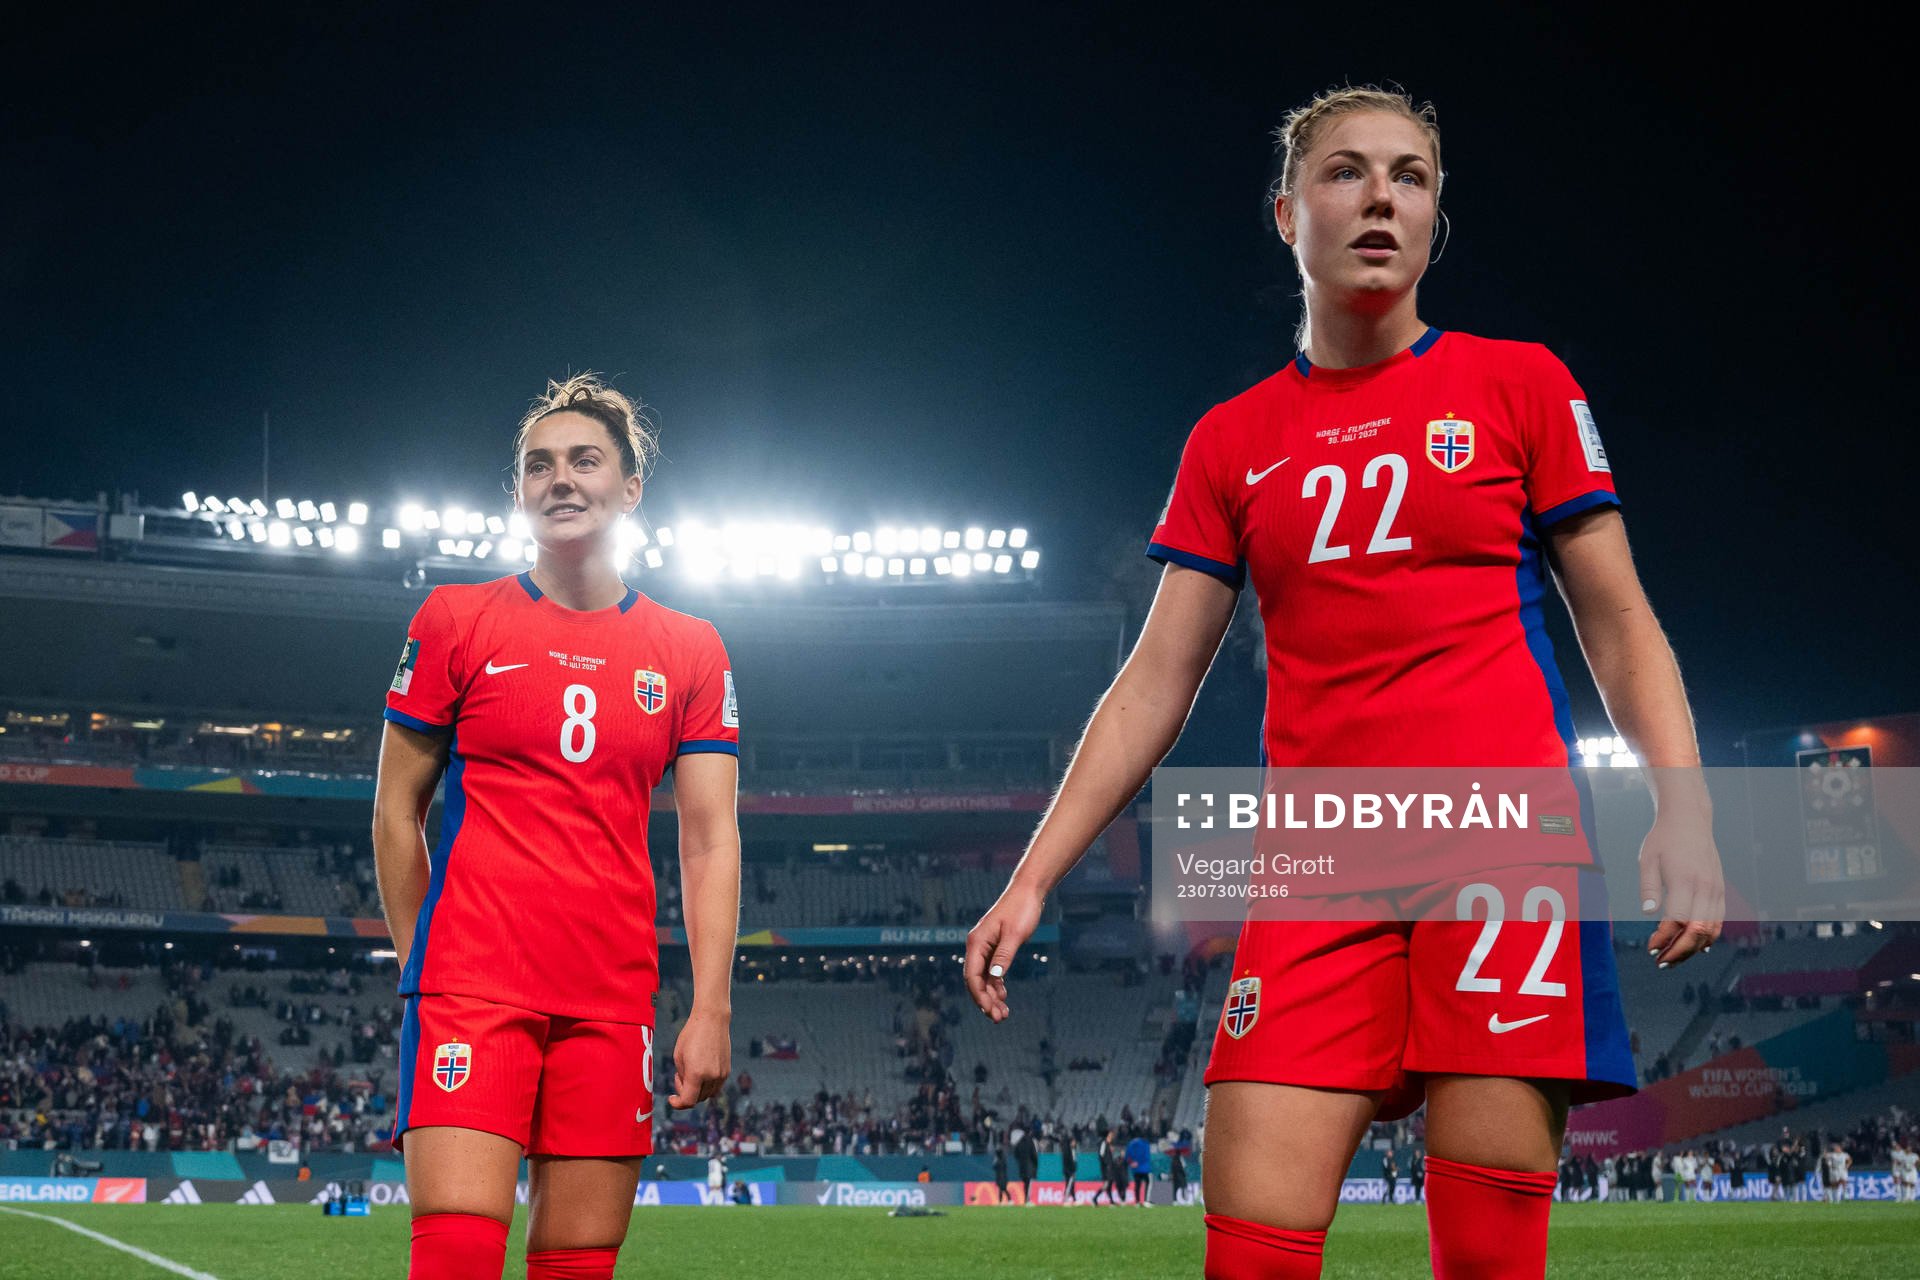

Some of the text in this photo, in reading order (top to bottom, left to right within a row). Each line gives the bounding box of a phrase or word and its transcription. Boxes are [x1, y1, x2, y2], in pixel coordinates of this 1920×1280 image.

[1316, 427, 1341, 438] NORGE
[1341, 433, 1357, 443] JULI
[1359, 428, 1378, 439] 2023
[1302, 452, 1412, 564] 22
[549, 650, 568, 660] NORGE
[570, 661, 580, 669] JULI
[582, 663, 597, 671] 2023
[560, 683, 597, 763] 8
[1456, 883, 1566, 997] 22
[1702, 1068, 1732, 1082] FIFA
[1689, 1082, 1741, 1097] WORLD
[1744, 1081, 1773, 1096] CUP
[837, 1182, 926, 1207] Rexona
